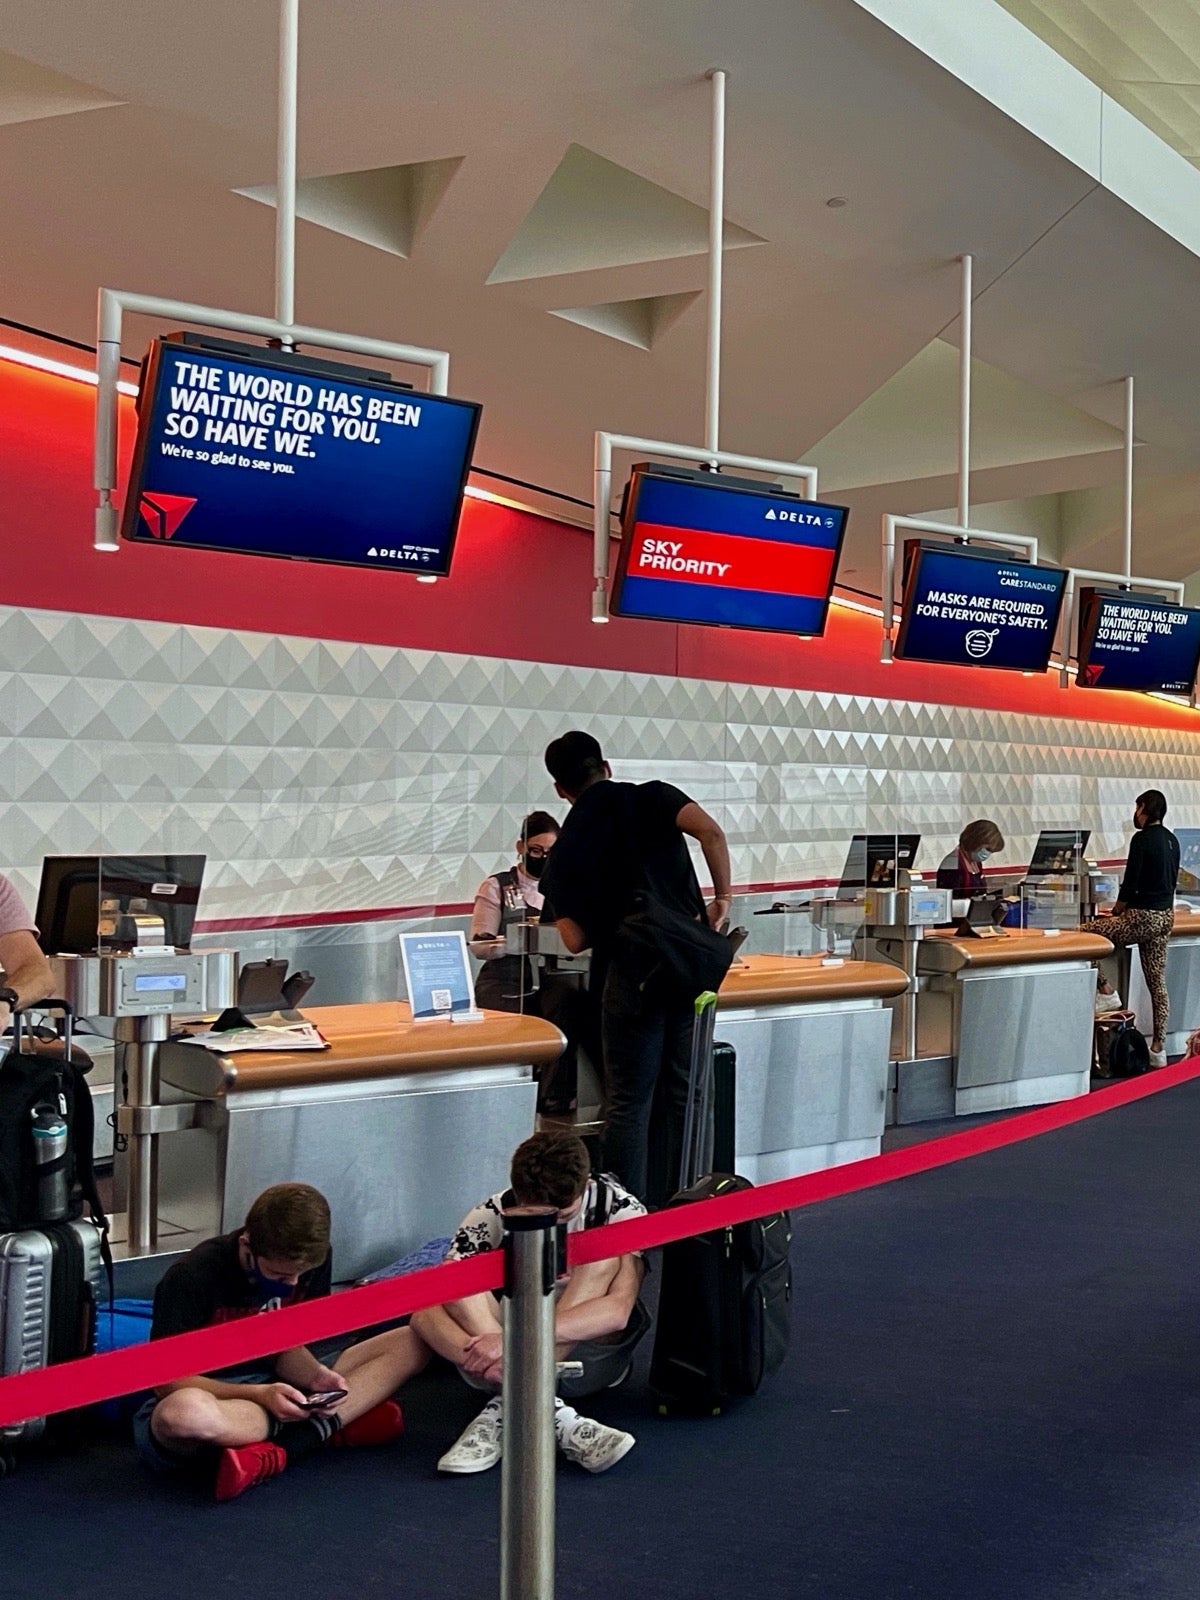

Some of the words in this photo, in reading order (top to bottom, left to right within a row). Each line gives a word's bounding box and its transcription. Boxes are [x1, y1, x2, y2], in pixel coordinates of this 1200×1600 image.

[175, 361, 223, 391] THE
[228, 371, 313, 407] WORLD
[318, 388, 363, 415] HAS
[366, 398, 421, 427] BEEN
[170, 387, 276, 427] WAITING
[280, 408, 325, 435] FOR
[331, 415, 381, 444] YOU.
[165, 413, 199, 438] SO
[204, 418, 267, 450] HAVE
[274, 431, 316, 458] WE.
[162, 442, 194, 460] We're
[196, 450, 210, 463] so
[211, 451, 236, 467] glad
[238, 456, 251, 468] to
[252, 459, 272, 472] see
[272, 461, 295, 475] you.
[779, 510, 822, 526] DELTA
[380, 549, 418, 560] DELTA
[642, 538, 683, 556] SKY
[639, 554, 731, 577] PRIORITY
[927, 590, 968, 607] MASKS
[969, 594, 992, 610] ARE
[992, 597, 1045, 616] REQUIRED
[1103, 604, 1120, 617] THE
[1120, 606, 1150, 620] WORLD
[1150, 610, 1168, 622] HAS
[1168, 612, 1188, 625] BEEN
[916, 604, 939, 618] FOR
[940, 606, 1008, 626] EVERYONE'S
[1008, 614, 1049, 630] SAFETY.
[1100, 616, 1136, 630] WAITING
[1136, 620, 1153, 632] FOR
[1154, 622, 1172, 635] YOU.
[1097, 628, 1109, 639] SO
[1110, 629, 1132, 642] HAVE
[1133, 632, 1149, 644] WE.
